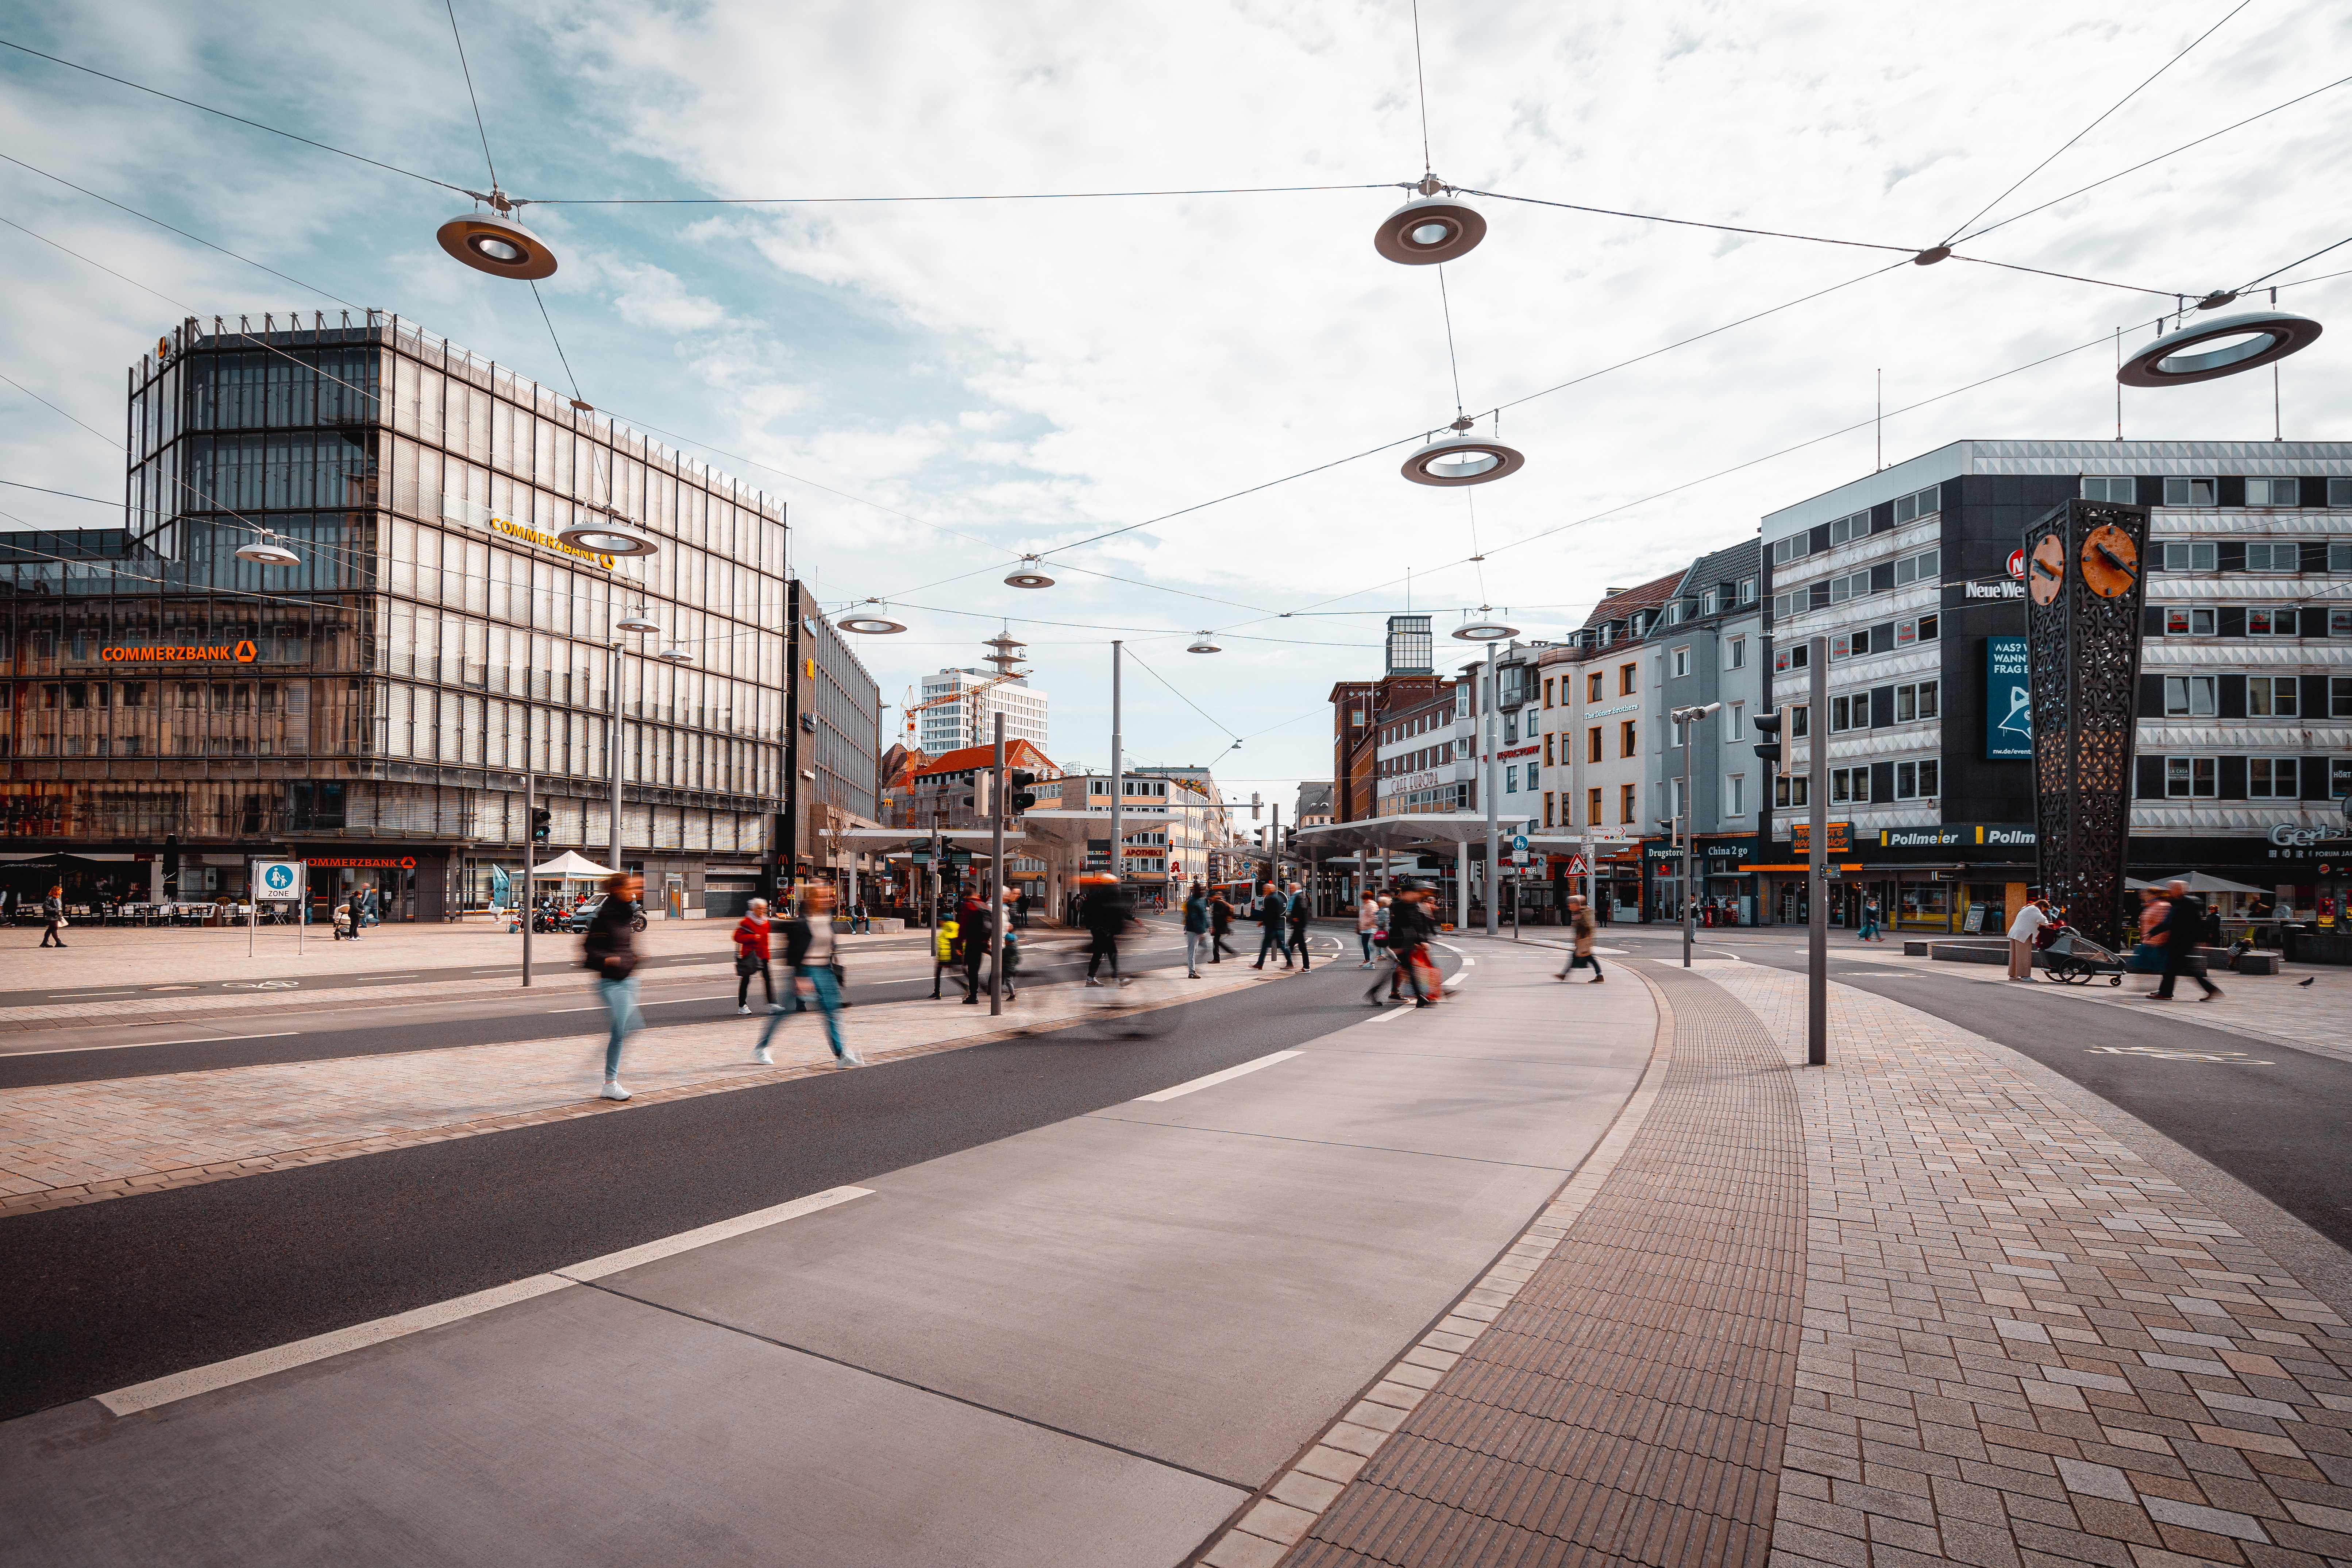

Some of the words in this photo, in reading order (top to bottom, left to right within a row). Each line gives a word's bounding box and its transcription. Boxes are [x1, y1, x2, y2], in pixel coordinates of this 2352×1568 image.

[1966, 582, 2001, 598] Neue
[2000, 582, 2025, 598] We
[102, 646, 231, 661] COMMERZBANK
[1994, 644, 2021, 652] WAS?
[1994, 665, 2021, 673] FRAG
[1595, 709, 1612, 718] Döner
[1612, 704, 1638, 714] Brothers
[1891, 830, 1958, 845] Pollmeier
[1649, 849, 1684, 859] Drugstore
[1708, 846, 1730, 855] China
[1732, 846, 1736, 854] 2
[1738, 848, 1748, 857] go
